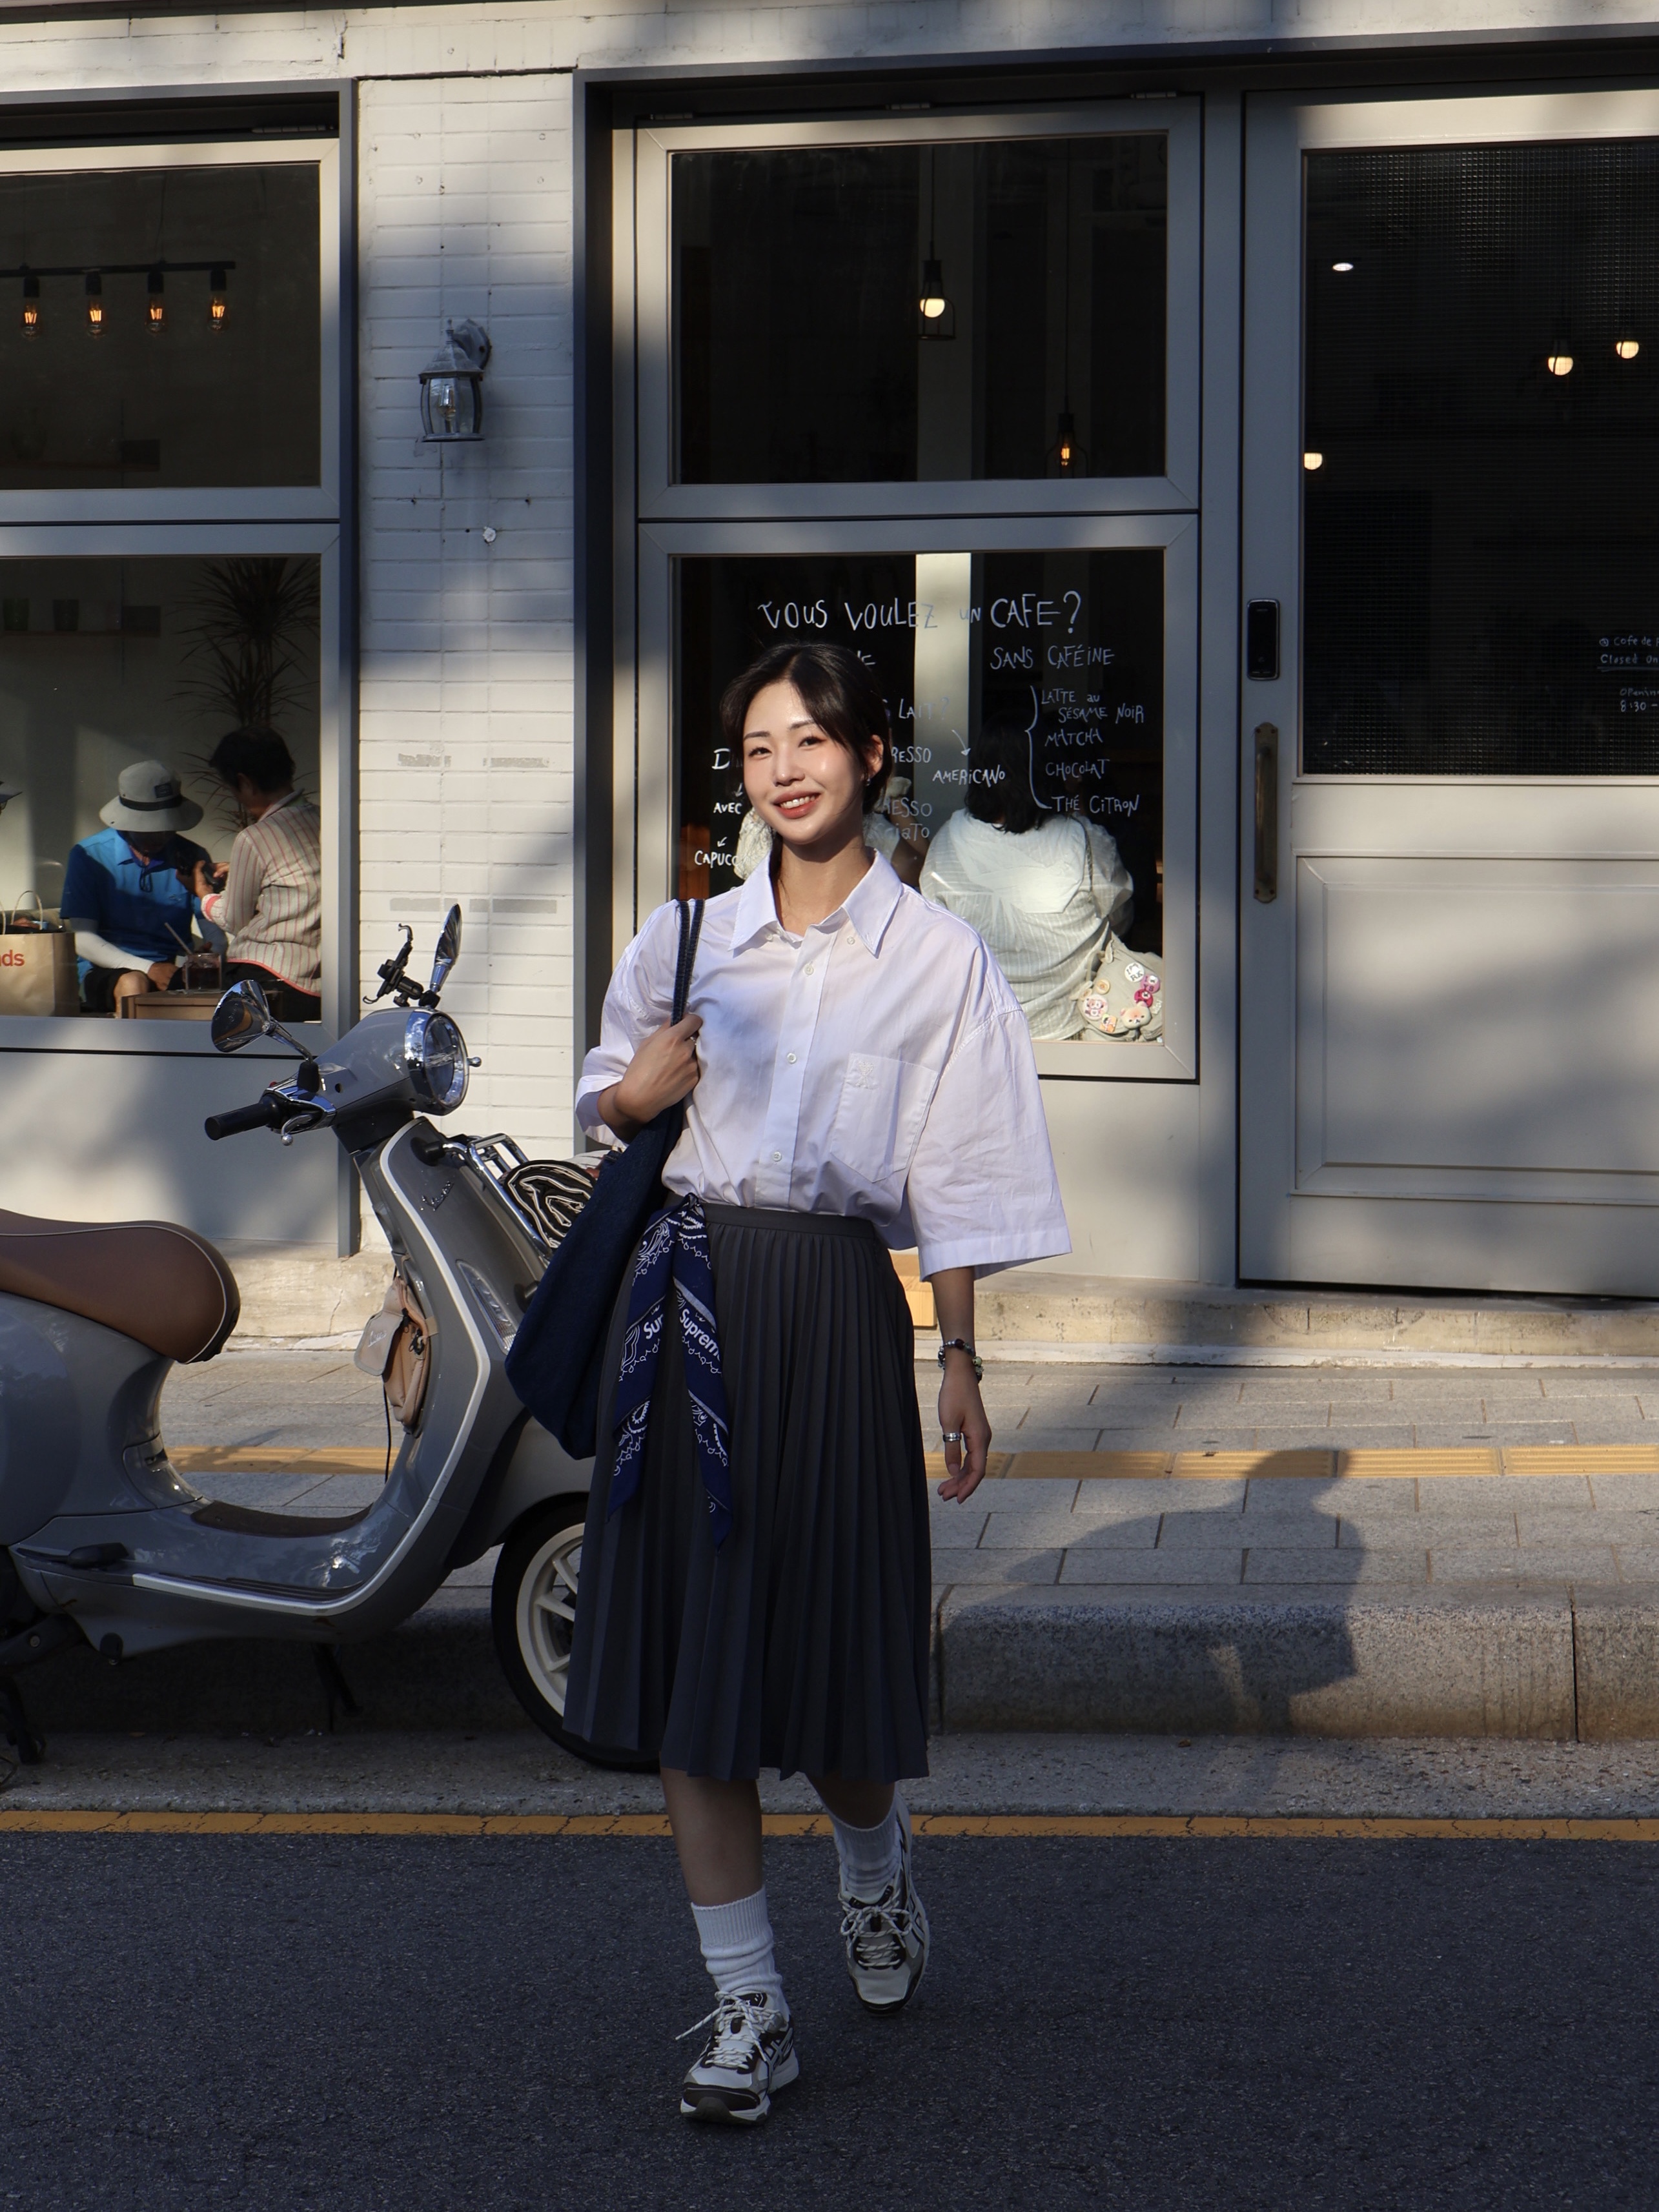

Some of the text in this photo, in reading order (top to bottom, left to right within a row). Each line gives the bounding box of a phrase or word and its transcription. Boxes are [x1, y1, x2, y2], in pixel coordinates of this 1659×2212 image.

[1642, 636, 1653, 646] de
[990, 646, 1033, 670] SANS
[1042, 688, 1076, 704] LATTE
[1044, 728, 1103, 747] MATCHA
[891, 746, 931, 764] RESSO
[881, 797, 932, 818] RESSO
[1052, 795, 1081, 813] THÉ
[0, 949, 25, 967] ds
[679, 1308, 720, 1362] Suprem
